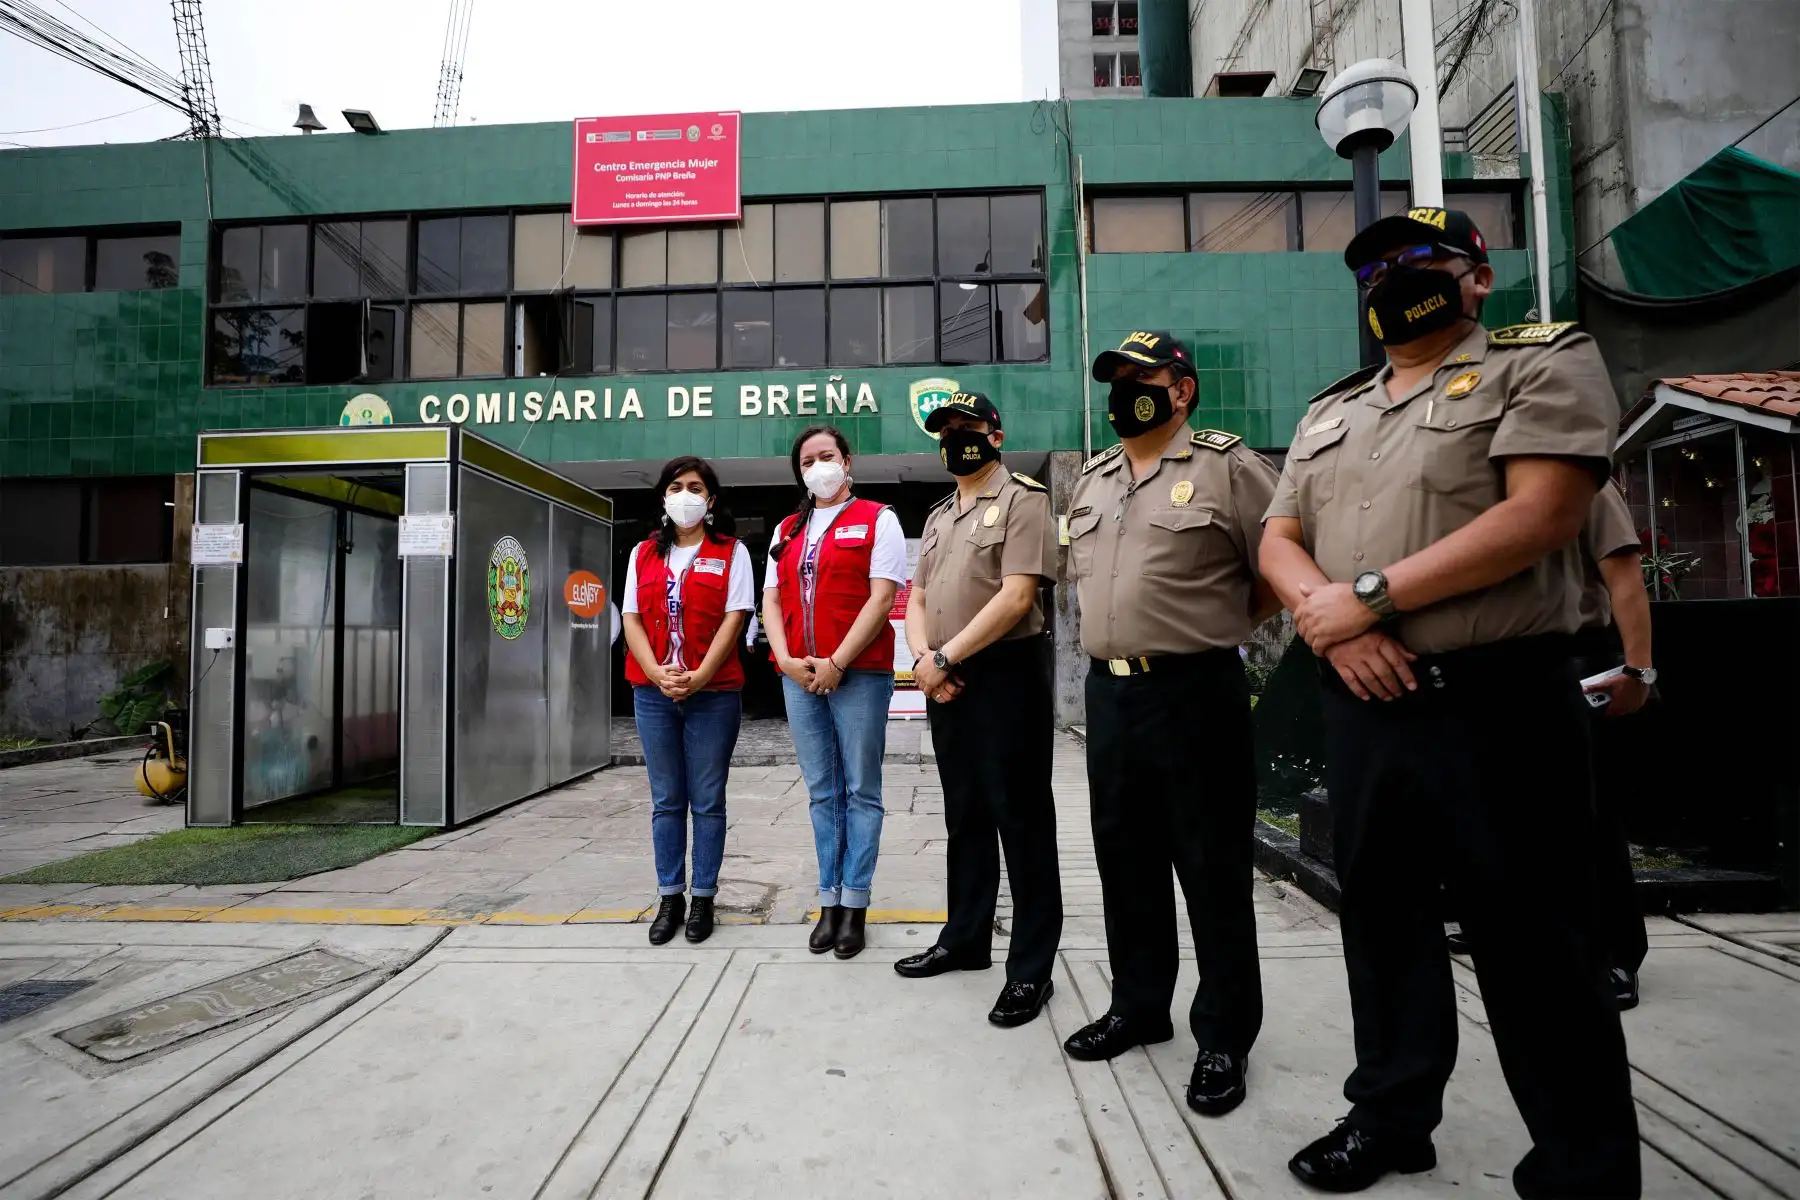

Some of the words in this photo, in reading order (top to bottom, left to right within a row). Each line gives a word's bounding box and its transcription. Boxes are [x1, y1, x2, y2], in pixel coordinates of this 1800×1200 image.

[594, 163, 627, 172] Centro
[629, 160, 686, 171] Emergencia
[688, 158, 718, 170] Mujer
[615, 173, 653, 182] Comisaría
[655, 172, 672, 181] PNP
[673, 171, 696, 180] Breña
[625, 192, 648, 200] Horario
[649, 191, 657, 199] de
[635, 200, 662, 209] domingo
[681, 198, 698, 206] horas
[1404, 293, 1448, 323] POLICIA
[419, 388, 645, 424] COMISARIA
[667, 386, 713, 417] DE
[740, 374, 879, 417] BREÑA
